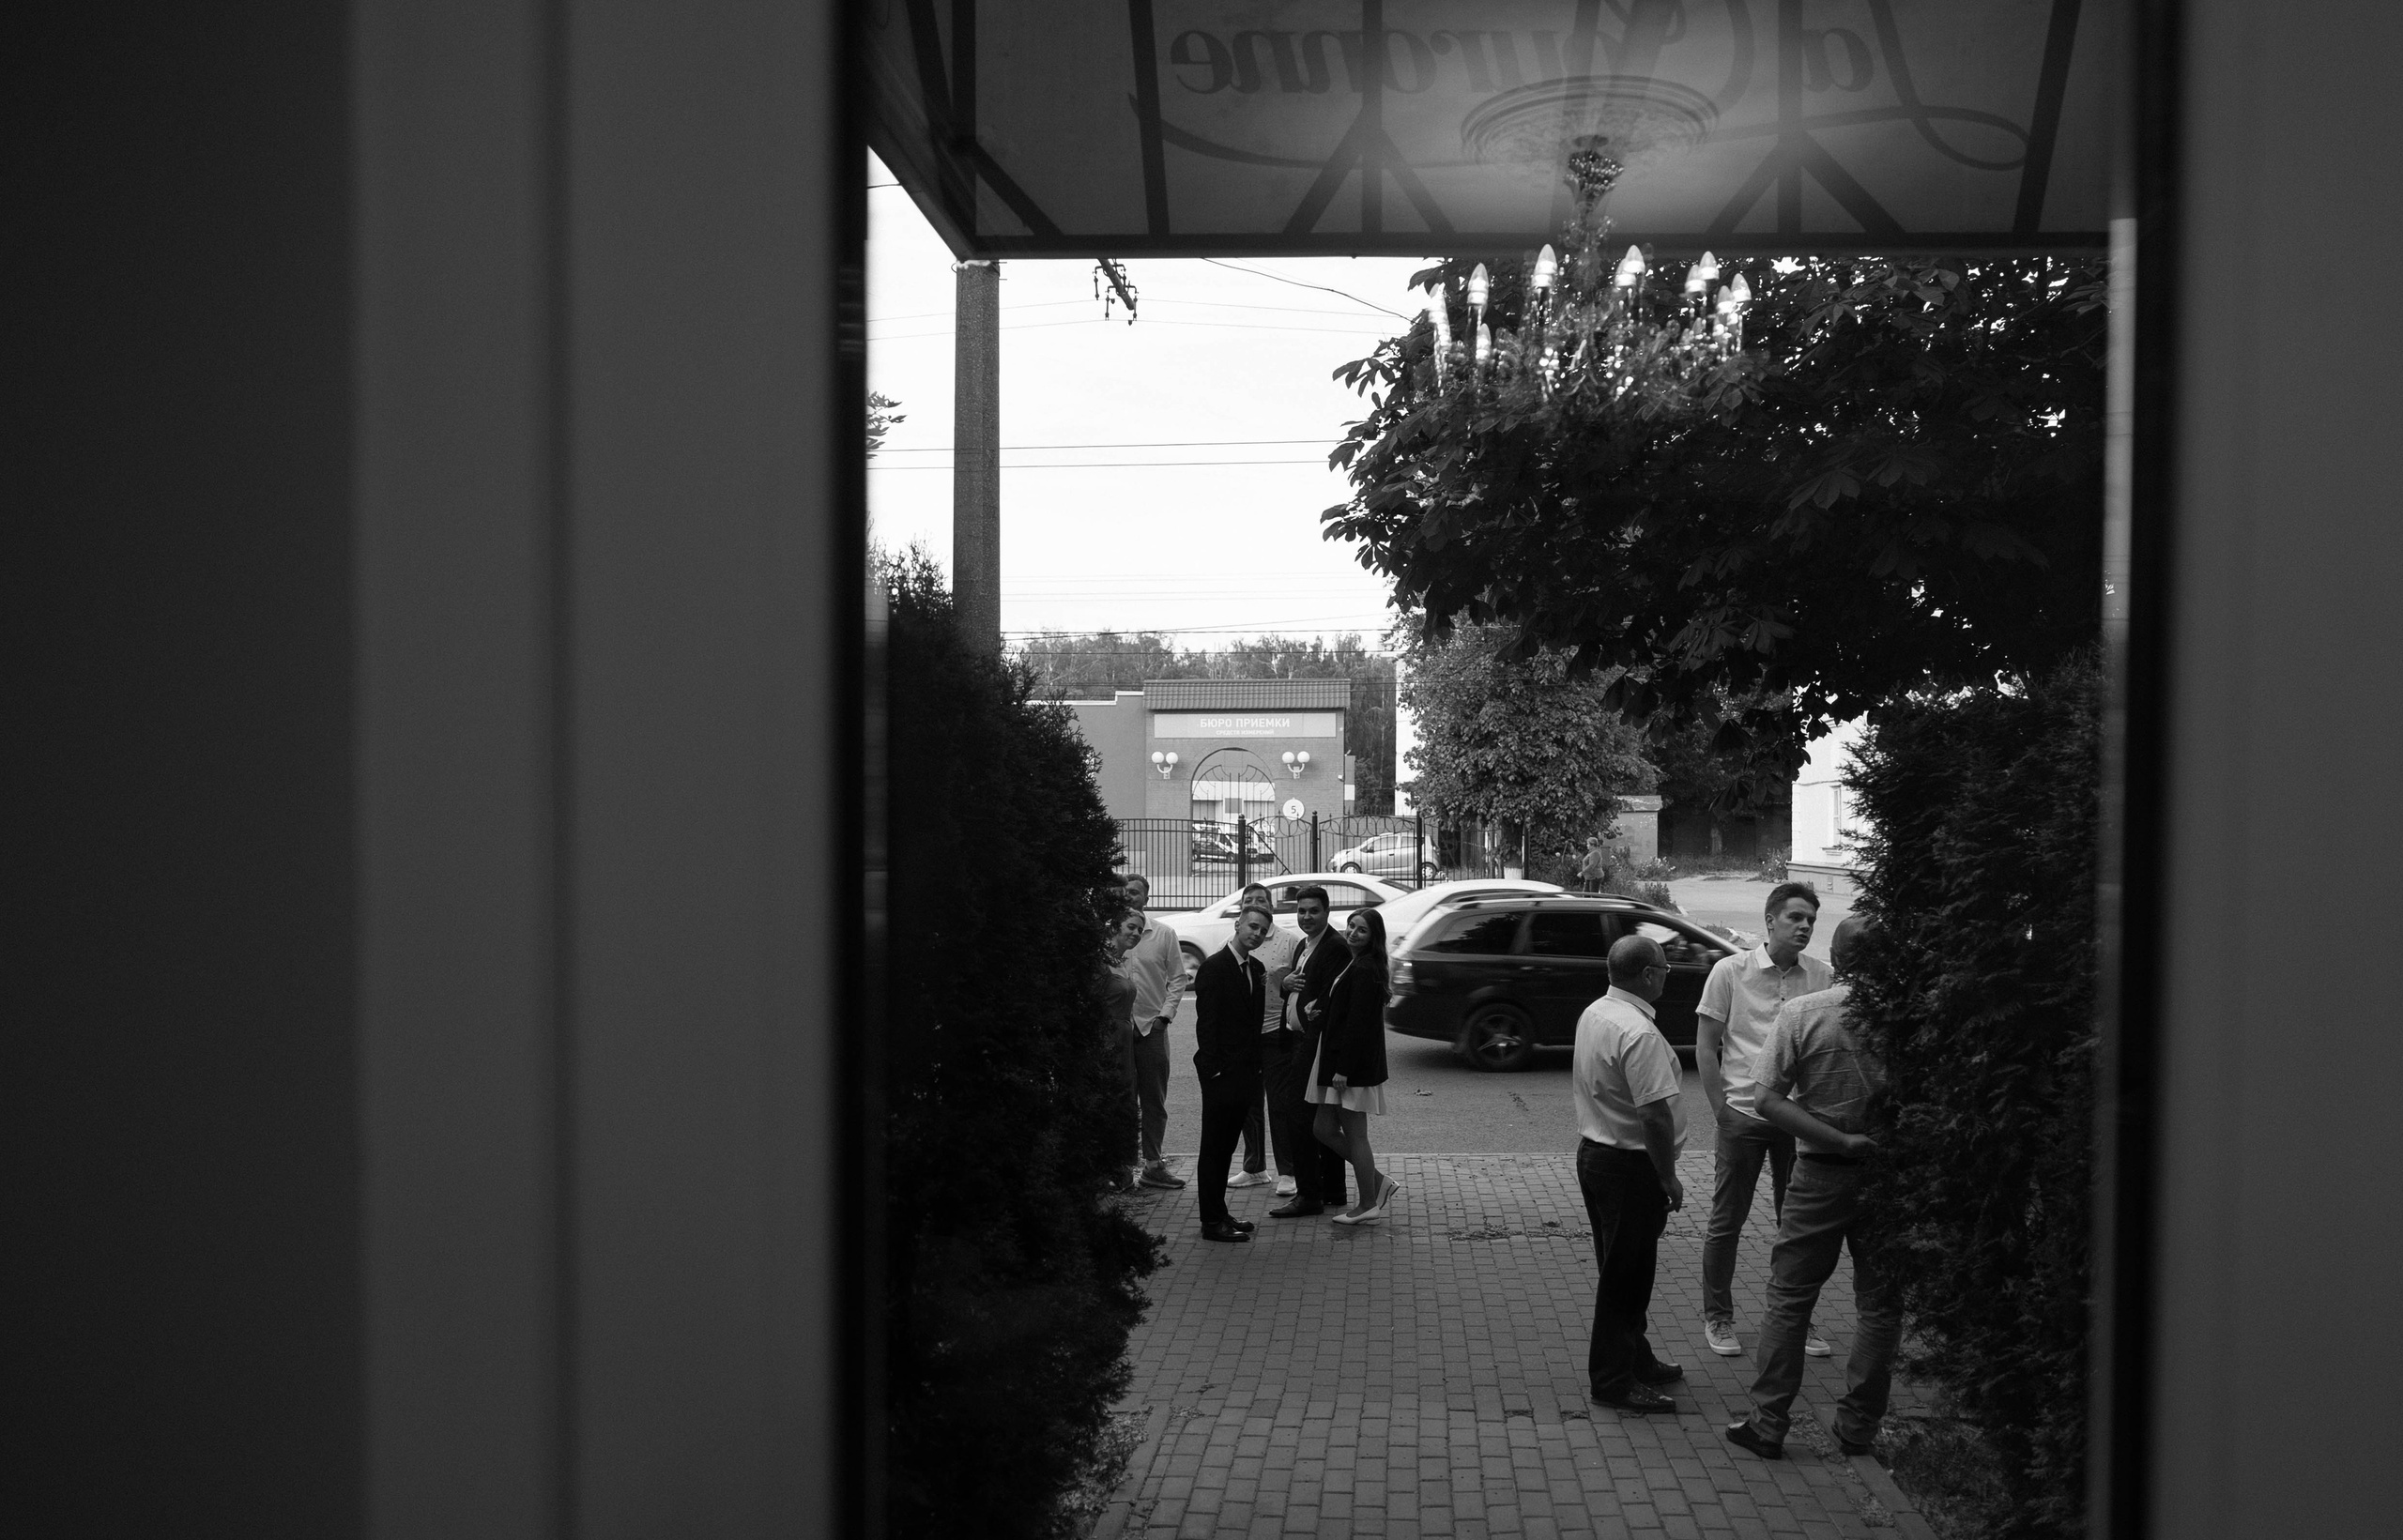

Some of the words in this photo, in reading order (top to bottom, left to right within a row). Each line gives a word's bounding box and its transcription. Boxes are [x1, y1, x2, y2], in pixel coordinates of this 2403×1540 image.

[1200, 718, 1232, 728] БЮРО
[1235, 717, 1291, 728] ПРИЕМКИ
[1291, 805, 1297, 815] 5
